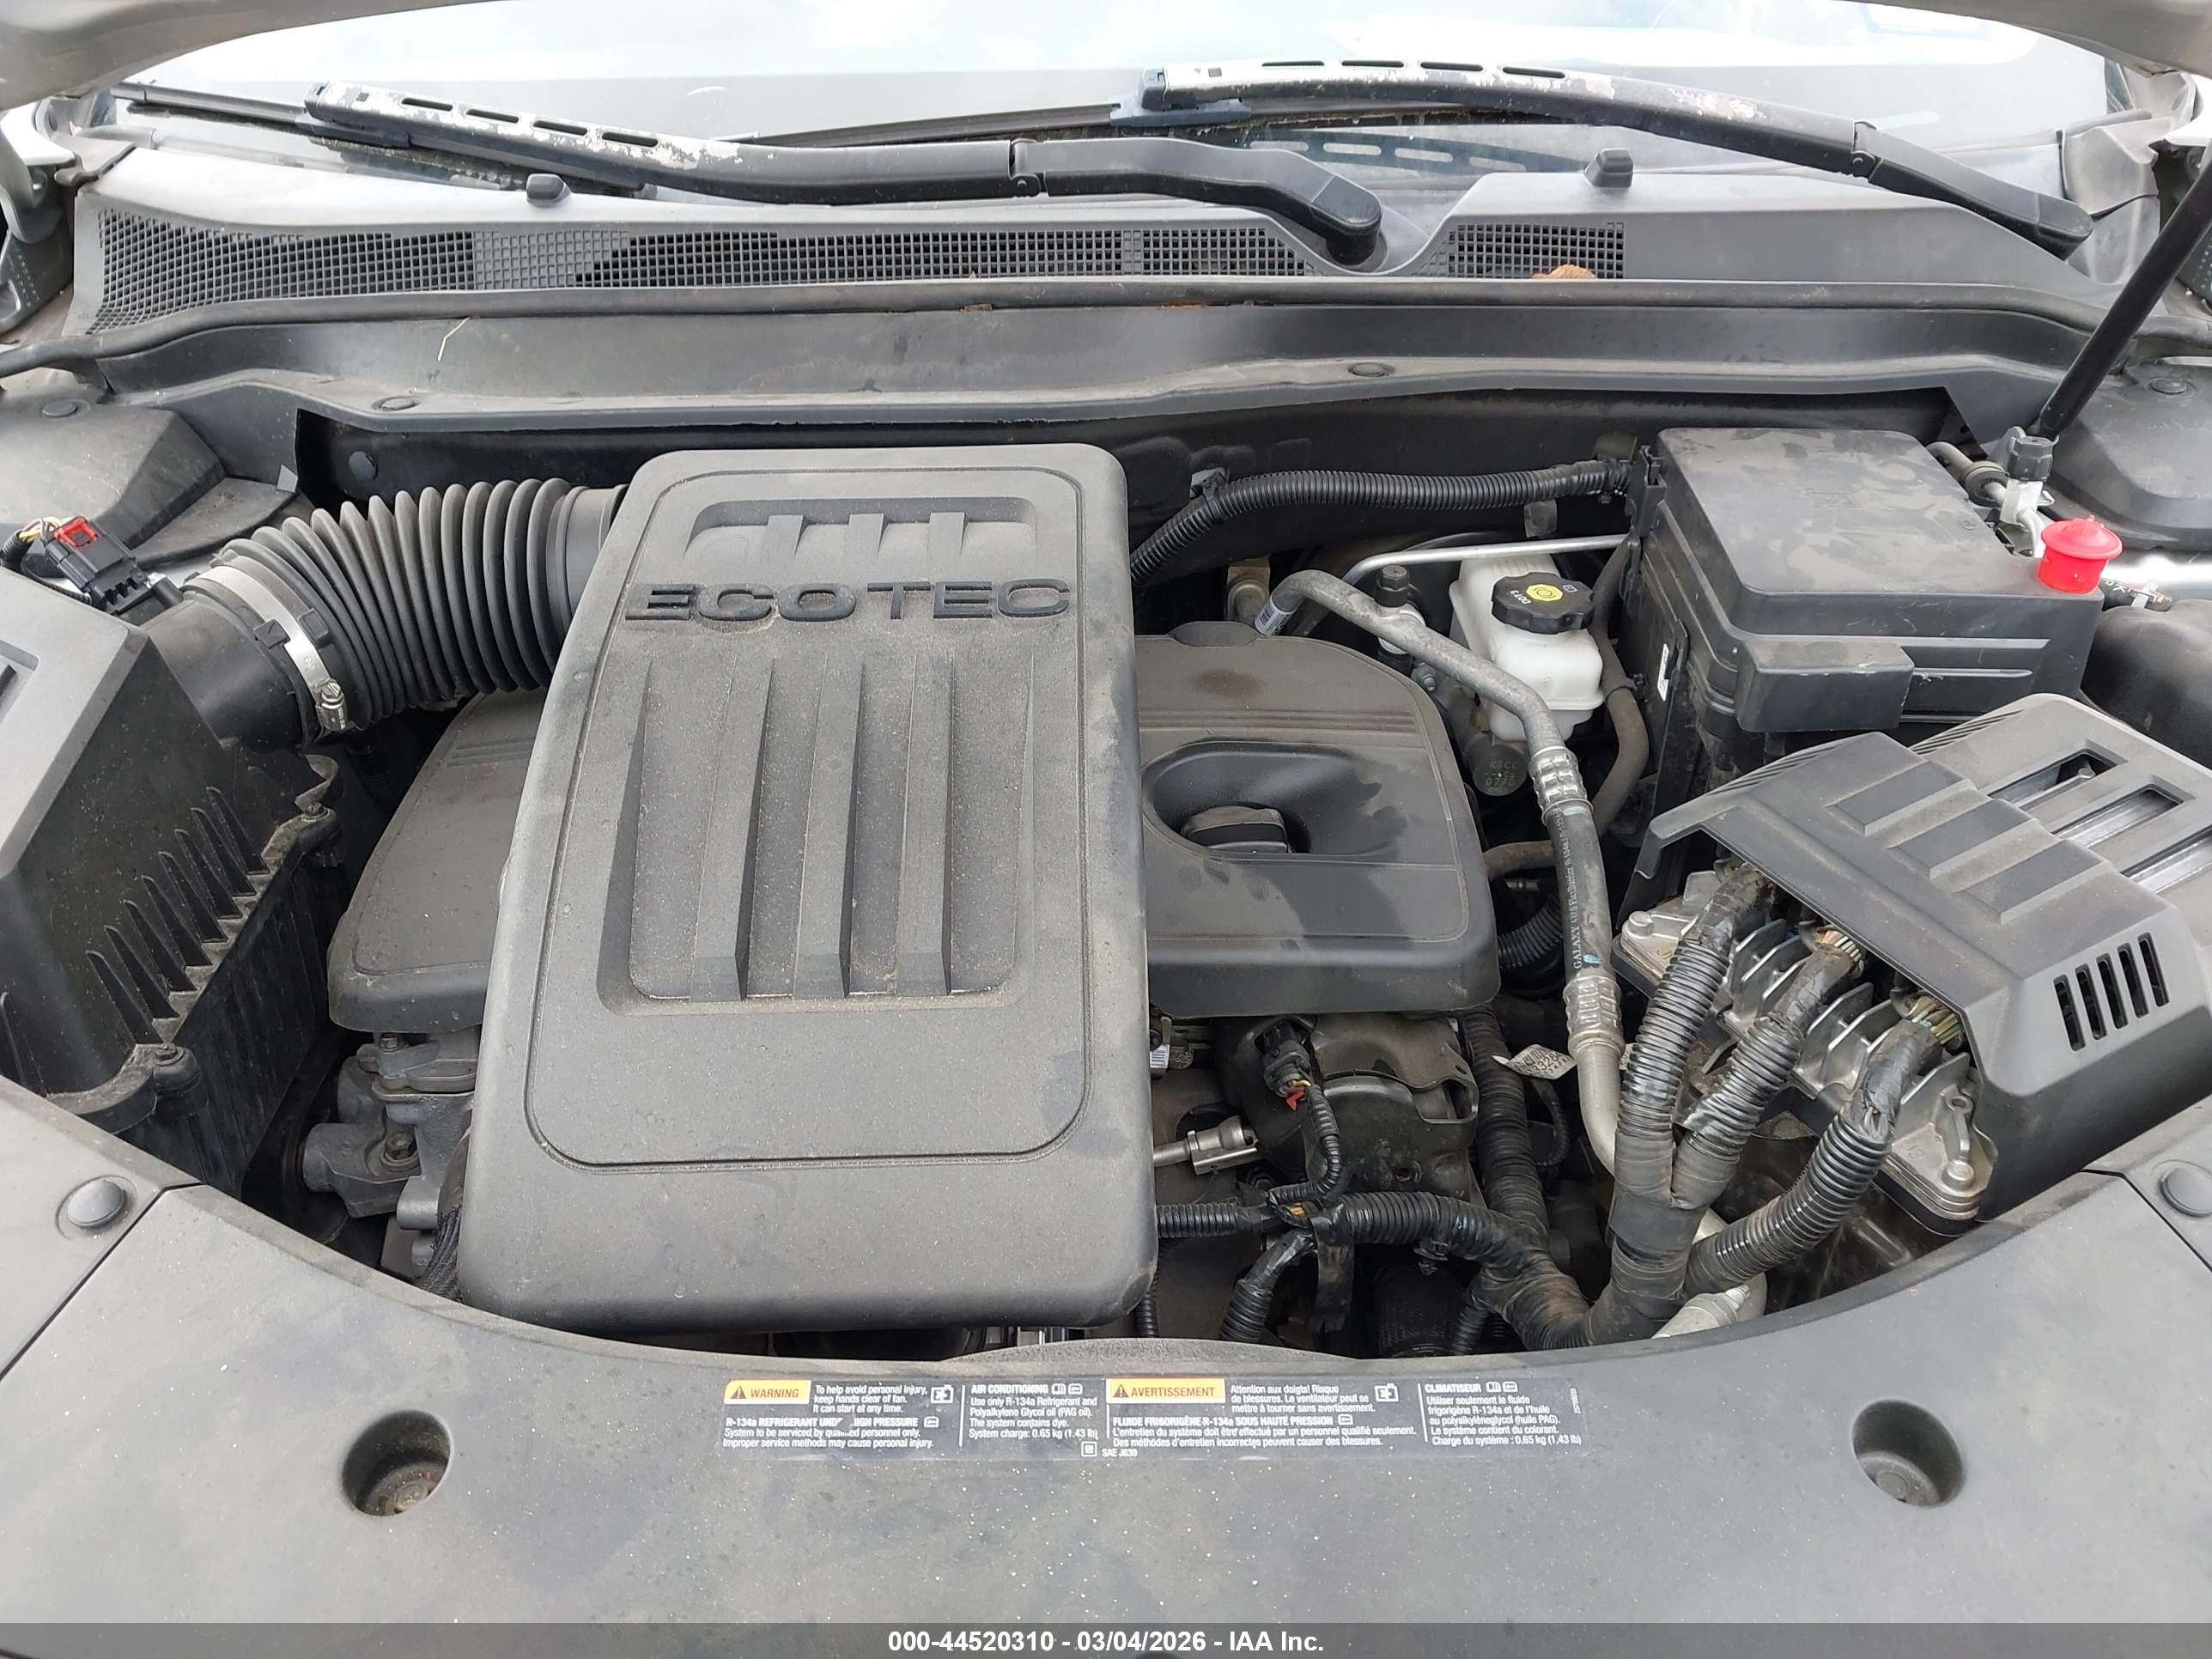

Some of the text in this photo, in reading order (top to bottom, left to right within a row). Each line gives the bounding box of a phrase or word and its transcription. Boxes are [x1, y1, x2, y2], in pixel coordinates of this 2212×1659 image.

[625, 578, 1070, 622] ECOTEC
[1510, 590, 1532, 605] DOT3
[1570, 926, 1583, 969] GALAXY
[815, 1385, 824, 1394] To
[827, 1385, 843, 1395] help
[845, 1385, 866, 1394] avoid
[868, 1385, 902, 1395] personal
[971, 1384, 1048, 1394] AIR CONDITIONING
[1131, 1387, 1216, 1397] AVERTISSEMENT
[1231, 1385, 1266, 1394] Attention
[1283, 1385, 1310, 1395] doigts!
[1311, 1385, 1340, 1395] Risque
[1425, 1383, 1482, 1393] CLIMATISEUR
[750, 1389, 799, 1398] WARNING
[813, 1395, 907, 1404] keep hands clear of fan.
[970, 1396, 1097, 1407] Use only R-134a Refrigerant and
[1231, 1395, 1242, 1403] de
[1243, 1395, 1283, 1403] blessures.
[1284, 1395, 1295, 1403] Le
[1296, 1395, 1338, 1403] ventilateur
[1340, 1395, 1358, 1404] peut
[1426, 1395, 1530, 1405] Utiliser seulement le fluide
[866, 1406, 882, 1414] any
[883, 1404, 903, 1413] time.
[969, 1407, 1018, 1417] Polyalkylene
[1020, 1407, 1044, 1417] Glycol
[1046, 1407, 1056, 1416] oil
[1058, 1407, 1077, 1417] (PAG
[1259, 1404, 1266, 1413] à
[1317, 1403, 1376, 1413] avertissement.
[1427, 1406, 1471, 1416] frigorigène
[1472, 1406, 1503, 1414] R-134a
[1504, 1406, 1513, 1414] et
[1514, 1406, 1524, 1414] de
[726, 1418, 757, 1427] R-134a
[758, 1418, 818, 1427] REFRIGERANT
[819, 1418, 844, 1427] UND
[873, 1418, 919, 1427] PRESSURE
[970, 1418, 1069, 1429] The system contains dye.
[1112, 1417, 1144, 1426] FLUIDE
[1235, 1417, 1259, 1425] SOUS
[1260, 1417, 1289, 1425] HAUTE
[1290, 1417, 1334, 1425] PRESSION
[1515, 1415, 1537, 1425] (huile
[724, 1428, 754, 1438] System
[756, 1428, 764, 1437] to
[766, 1428, 777, 1437] be
[778, 1428, 811, 1437] serviced
[813, 1428, 824, 1438] by
[860, 1429, 901, 1438] personnel
[902, 1429, 921, 1438] only.
[969, 1429, 999, 1439] System
[1000, 1429, 1030, 1439] charge:
[1031, 1429, 1051, 1437] 0.65
[1052, 1429, 1062, 1438] kg
[1064, 1429, 1085, 1438] (1.43
[1156, 1428, 1168, 1437] du
[1169, 1428, 1202, 1438] système
[1203, 1427, 1219, 1437] doit
[1238, 1427, 1271, 1437] effectué
[1273, 1428, 1287, 1437] par
[1299, 1426, 1340, 1437] personnel
[1341, 1426, 1371, 1437] qualifié
[1372, 1426, 1416, 1435] seulement.
[1431, 1426, 1442, 1435] Le
[1443, 1426, 1477, 1437] système
[1478, 1425, 1510, 1435] contient
[1511, 1425, 1523, 1434] du
[723, 1438, 933, 1449] Improper service methods may cause personal injury.
[1113, 1438, 1128, 1447] Des
[1130, 1438, 1170, 1447] méthodes
[1216, 1438, 1261, 1448] incorrectes
[1262, 1437, 1295, 1448] peuvent
[1325, 1437, 1340, 1446] des
[1341, 1437, 1383, 1446] blessures.
[1432, 1437, 1462, 1448] Charge
[1462, 1437, 1474, 1445] du
[1475, 1436, 1510, 1447] système
[1516, 1435, 1534, 1446] 0,65
[1534, 1435, 1547, 1446] kg
[1547, 1435, 1570, 1446] (1,43
[1571, 1435, 1582, 1446] lb)
[1102, 1449, 1117, 1457] SAE
